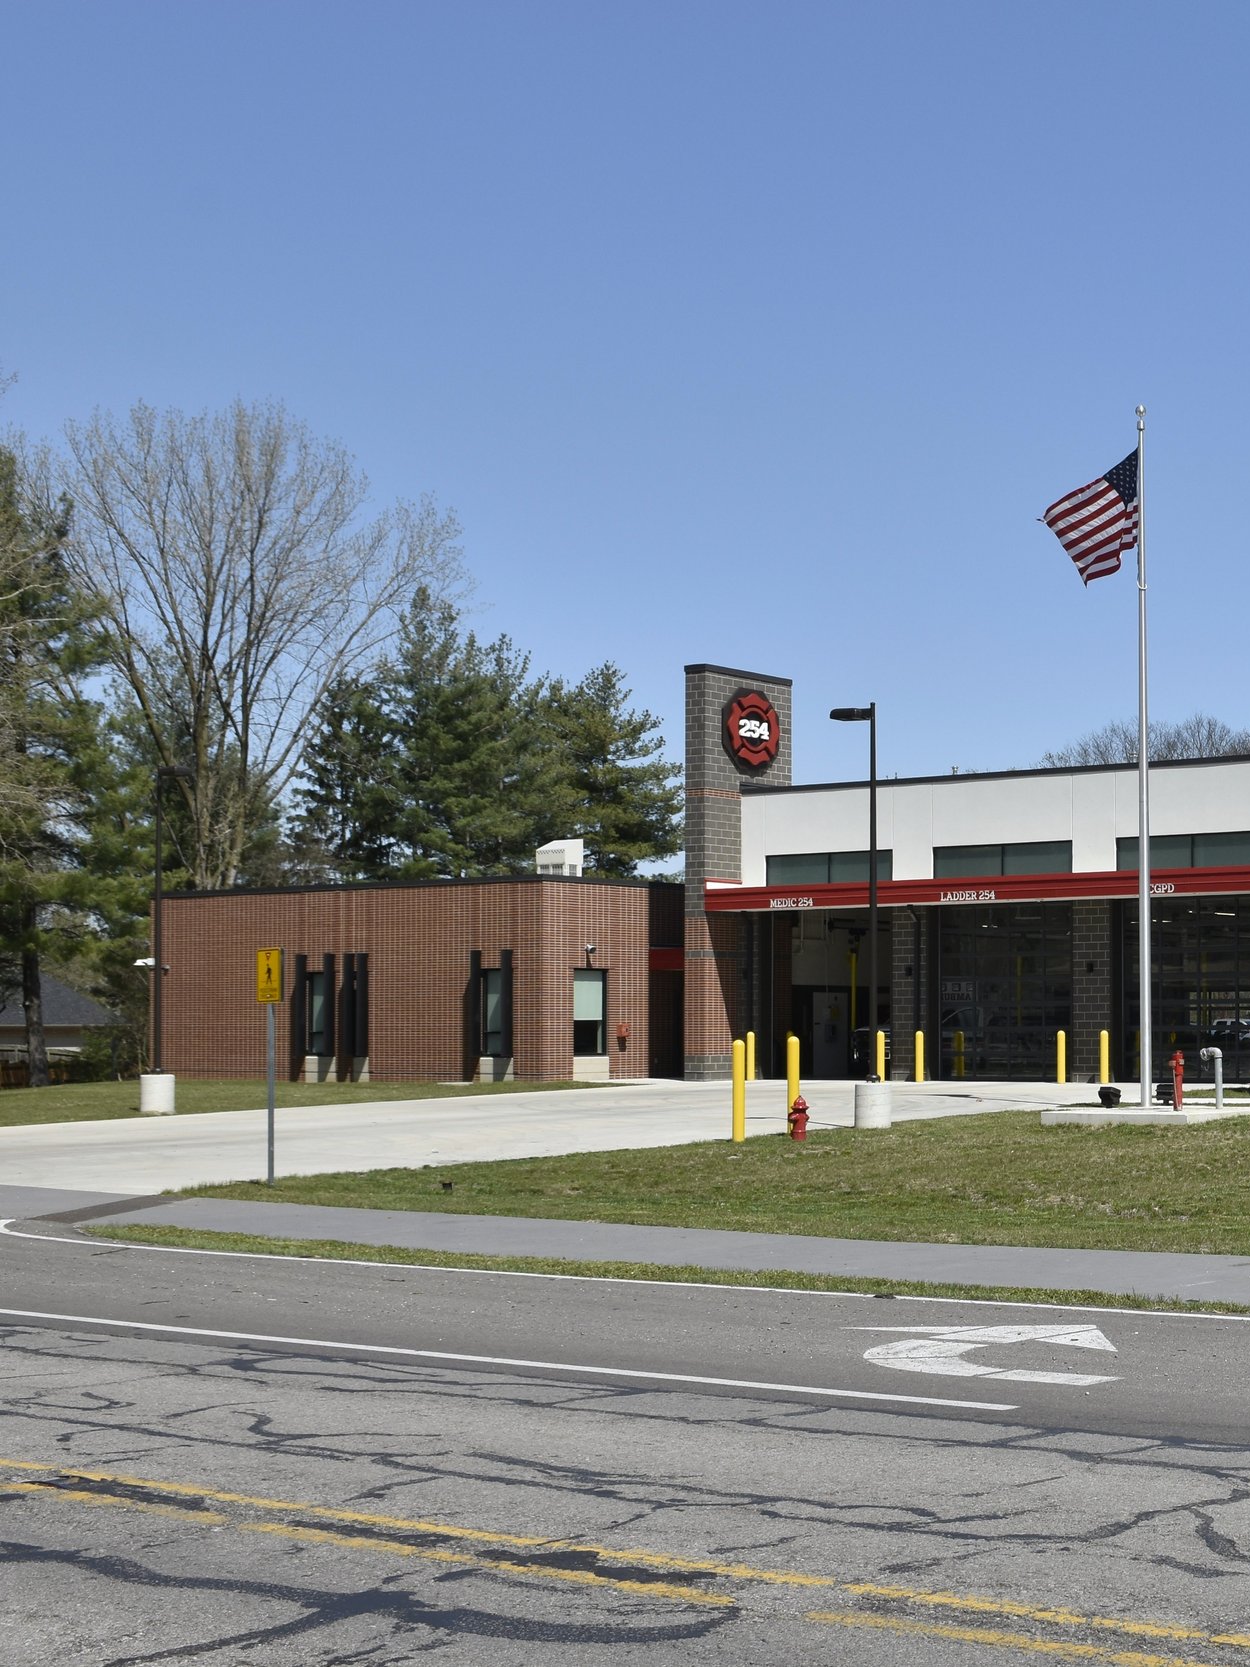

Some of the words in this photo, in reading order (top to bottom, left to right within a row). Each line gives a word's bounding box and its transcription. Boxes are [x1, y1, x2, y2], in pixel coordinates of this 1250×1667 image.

[739, 719, 769, 740] 254
[940, 890, 977, 901] LADDER
[978, 889, 995, 900] 254
[769, 897, 797, 908] MEDIC
[798, 897, 813, 907] 254
